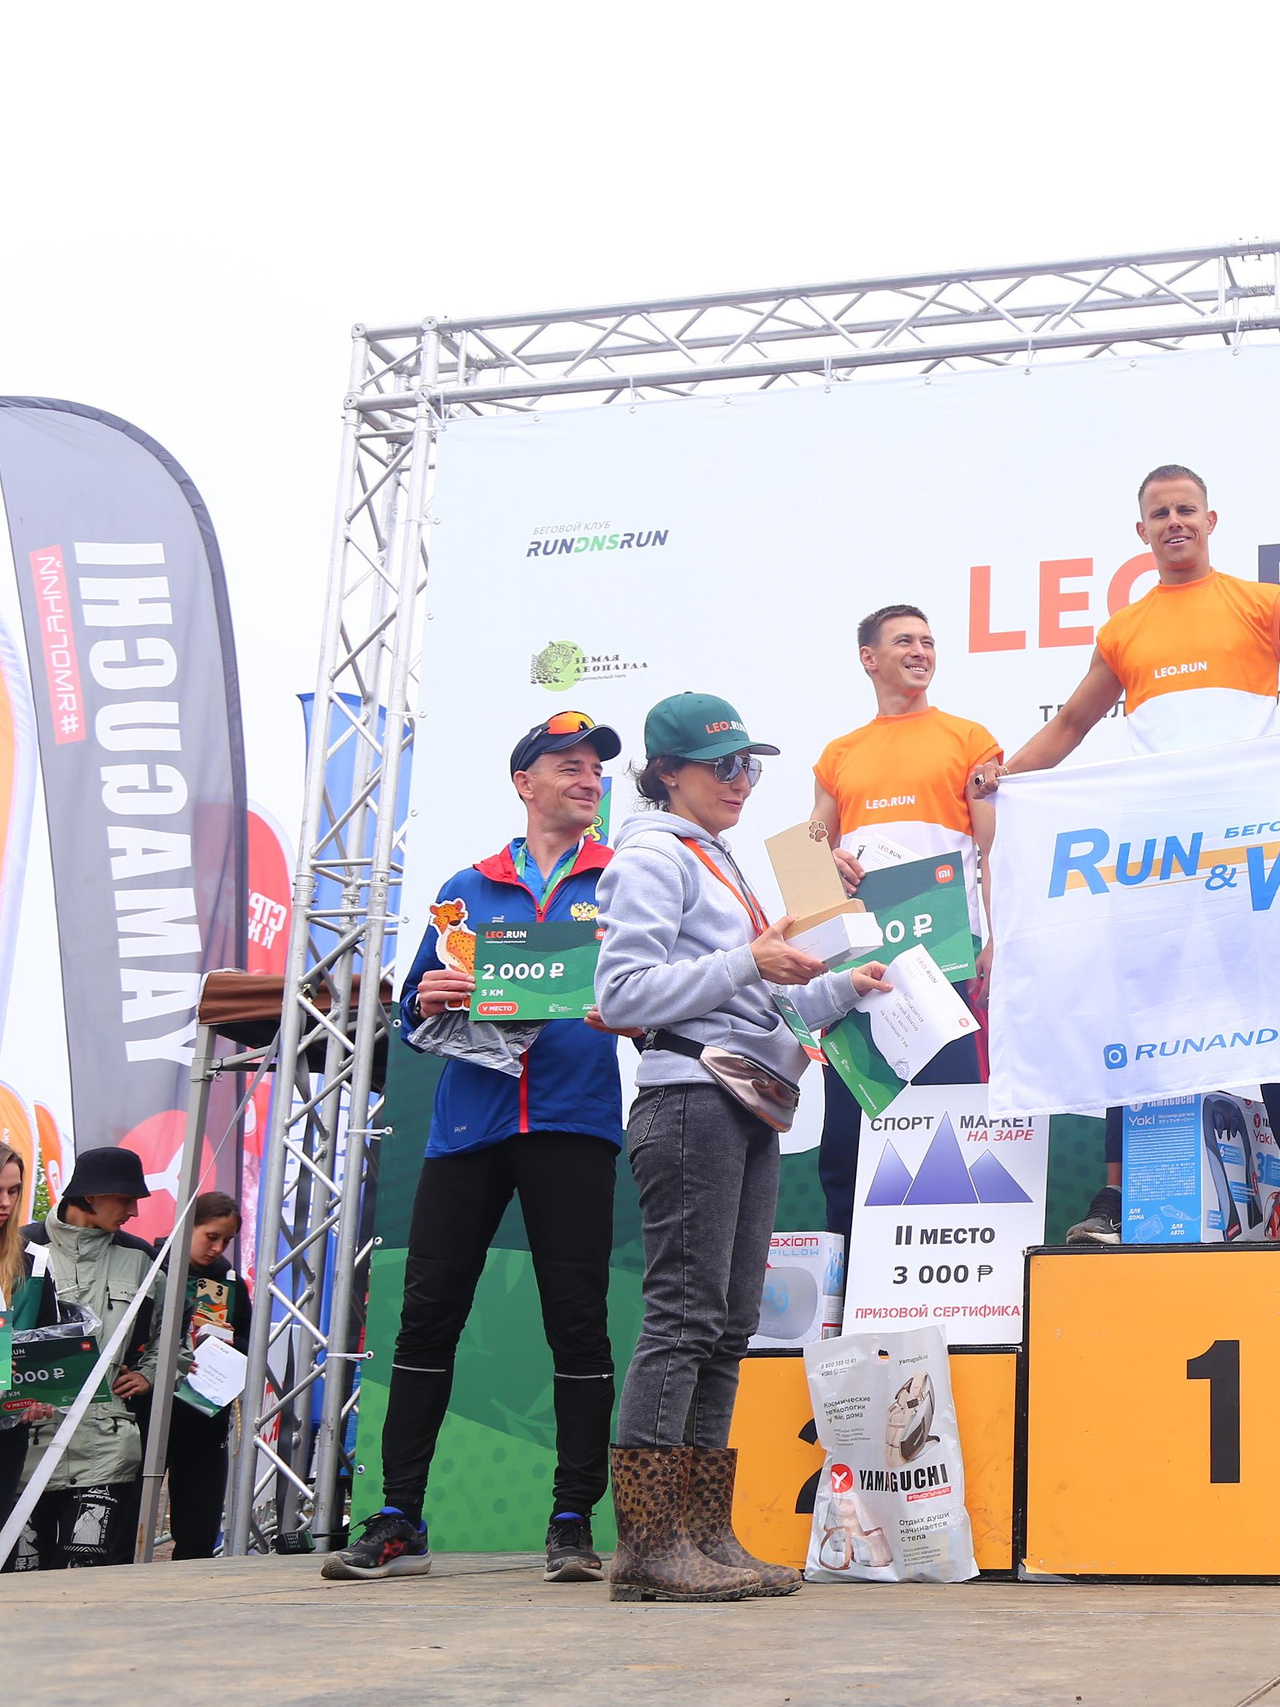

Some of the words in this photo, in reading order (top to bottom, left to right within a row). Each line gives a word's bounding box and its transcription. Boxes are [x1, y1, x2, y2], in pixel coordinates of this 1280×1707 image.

[533, 522, 581, 535] БЕГОВОЙ
[584, 520, 611, 531] КЛУБ
[526, 530, 669, 557] RUNDNSRUN
[1154, 661, 1208, 679] LEO.RUN
[865, 795, 915, 810] LEO.RUN
[877, 844, 902, 859] LEO.RUN
[1204, 864, 1237, 891] &
[485, 930, 527, 939] LEO.RUN
[481, 963, 495, 979] 2
[499, 963, 545, 979] 000
[870, 1116, 934, 1131] СПОРТ
[1129, 1115, 1155, 1126] Yoki
[967, 1131, 988, 1142] НА
[993, 1129, 1035, 1142] ЗАРЕ
[1253, 1129, 1272, 1145] Yoki
[1219, 1145, 1225, 1157] 6
[895, 1225, 913, 1245] II
[920, 1227, 995, 1245] МЕСТО
[892, 1266, 908, 1284] 3
[918, 1264, 969, 1284] 000
[216, 1285, 223, 1296] 3
[855, 1304, 928, 1319] ПРИЗОВОЙ
[933, 1304, 1022, 1318] СЕРТИФИКА
[899, 1355, 928, 1365] yamaguchi.ru
[824, 1396, 871, 1408] Космические
[825, 1404, 866, 1416] технологии
[846, 1412, 863, 1420] дома
[1186, 1340, 1240, 1483] 1
[859, 1463, 949, 1492] YAMAGUCHI
[899, 1517, 925, 1526] Отдых
[927, 1512, 950, 1522] души
[900, 1521, 948, 1534] начинается
[908, 1534, 926, 1542] тела
